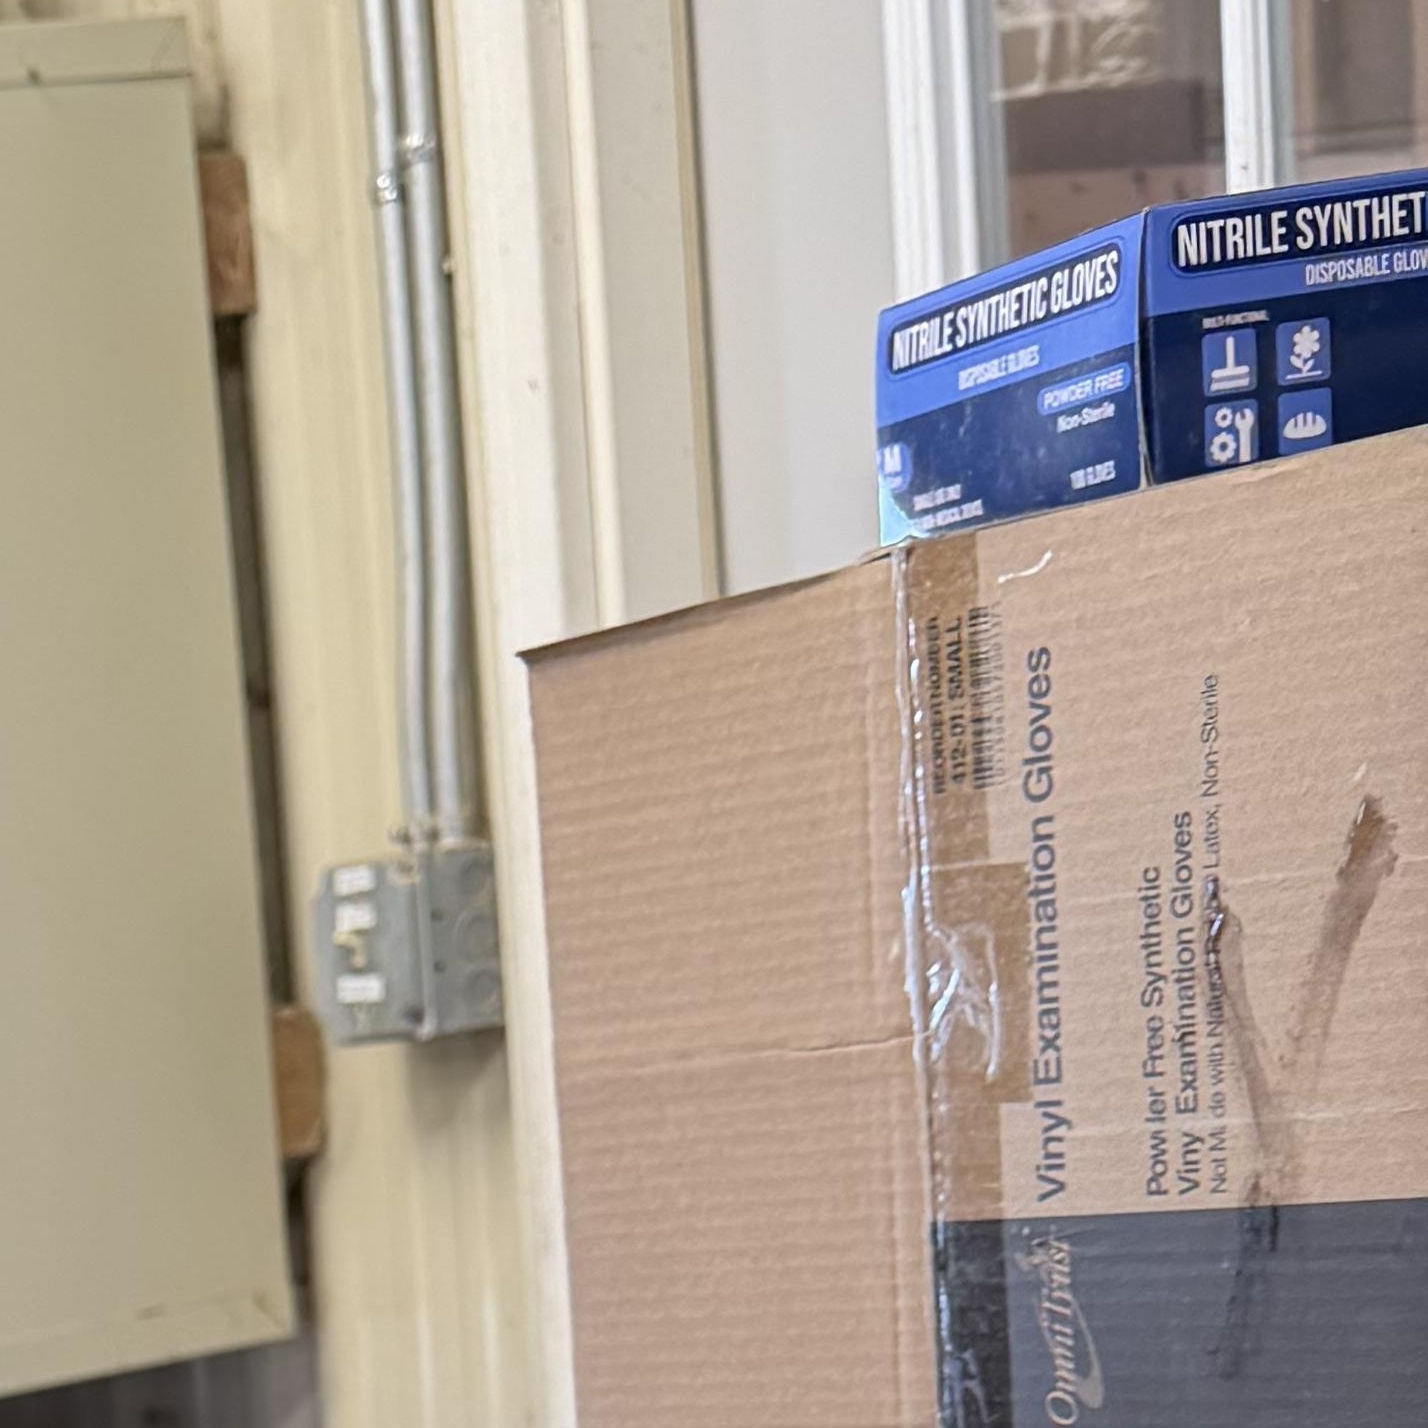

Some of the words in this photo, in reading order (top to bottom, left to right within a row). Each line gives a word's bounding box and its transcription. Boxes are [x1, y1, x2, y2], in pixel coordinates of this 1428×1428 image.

[1177, 210, 1289, 268] NITRILE
[1296, 191, 1426, 250] SYNTHET
[1305, 253, 1390, 286] DISPOSABLE
[893, 311, 953, 371] NITRILE
[955, 276, 1048, 349] SYNTHETIC
[1050, 249, 1119, 314] GLOVES
[1044, 378, 1093, 408] POWDER
[1094, 368, 1125, 394] FREE
[1022, 646, 1055, 803] Gloves
[1199, 674, 1220, 797] Non-Sterile
[1169, 811, 1193, 918] Gloves
[1202, 804, 1222, 869] Latex,
[1028, 814, 1063, 1084] Examination
[1139, 866, 1168, 1007] Synthetic
[1142, 1015, 1165, 1078] Free
[1171, 927, 1199, 1114] Examination
[1205, 1044, 1225, 1086] with
[1035, 1100, 1072, 1202] Vinyl
[1175, 1130, 1204, 1196] Viny
[1207, 1158, 1227, 1194] Not
